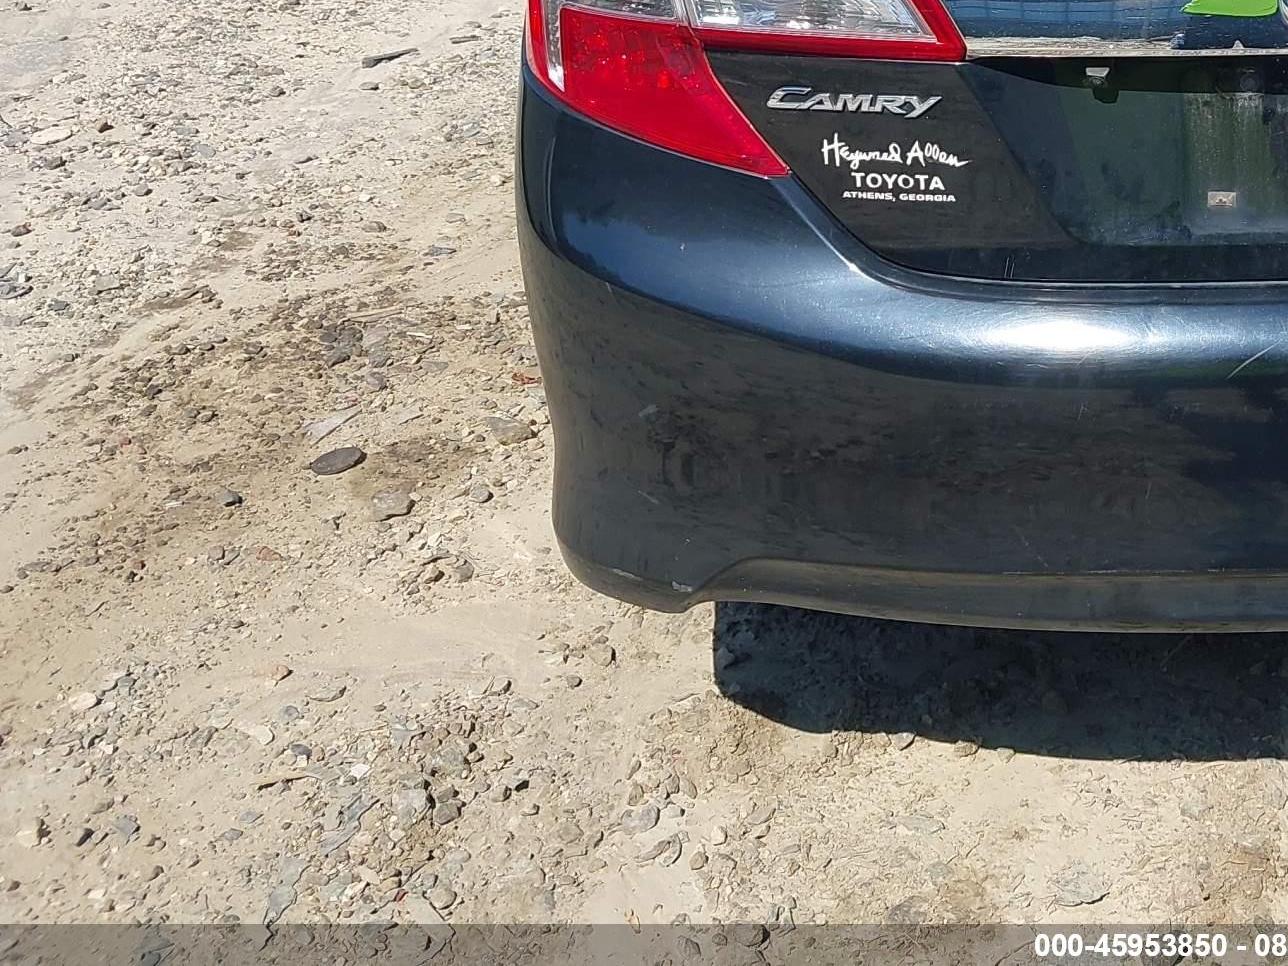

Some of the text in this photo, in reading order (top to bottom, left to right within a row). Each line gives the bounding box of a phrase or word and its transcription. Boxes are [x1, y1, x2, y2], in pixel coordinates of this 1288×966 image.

[906, 140, 973, 167] Allen
[851, 172, 945, 191] TOYOTA
[842, 190, 956, 202] ATHENS, GEORGIA
